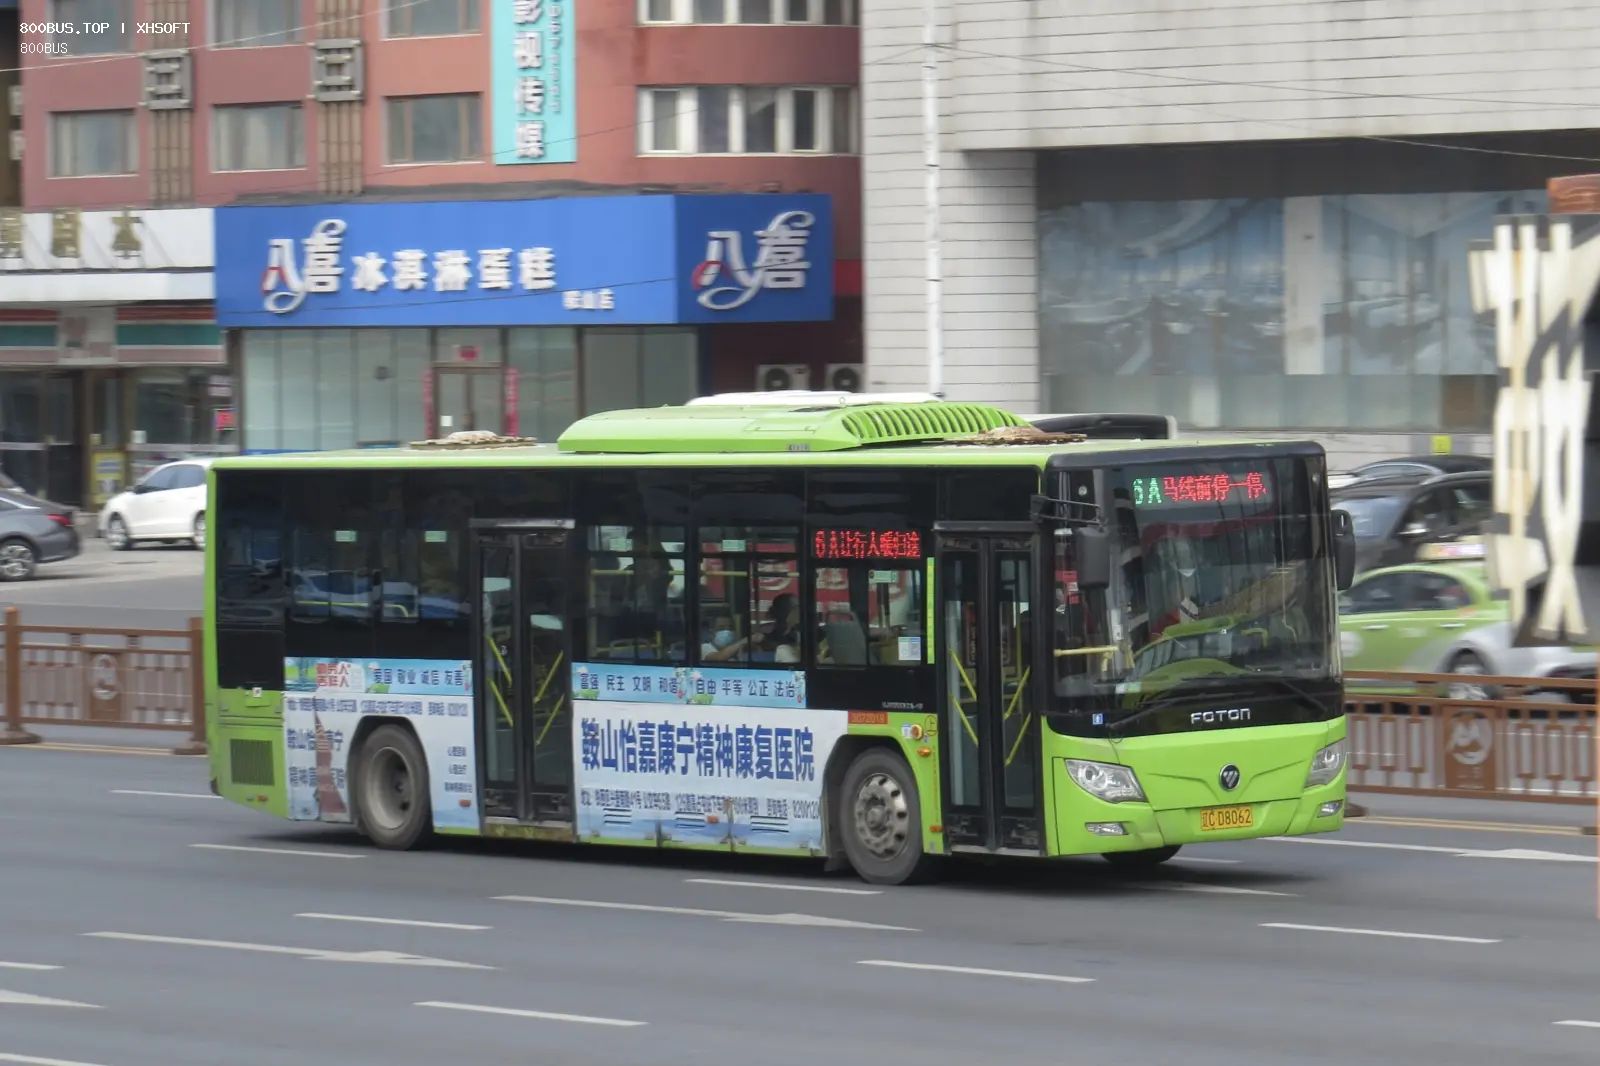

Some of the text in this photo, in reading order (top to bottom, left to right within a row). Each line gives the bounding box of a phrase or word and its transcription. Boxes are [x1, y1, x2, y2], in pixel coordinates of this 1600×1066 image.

[262, 218, 558, 314] 八喜 冰淇淋蛋糕
[691, 210, 816, 310] 八喜
[580, 673, 679, 694] 富强 民主 文明 和谐
[696, 679, 796, 698] 自由 平等 公正 法治
[1190, 708, 1251, 725] FOTON
[581, 717, 815, 783] 鞍山怡嘉康宁精神康复医院
